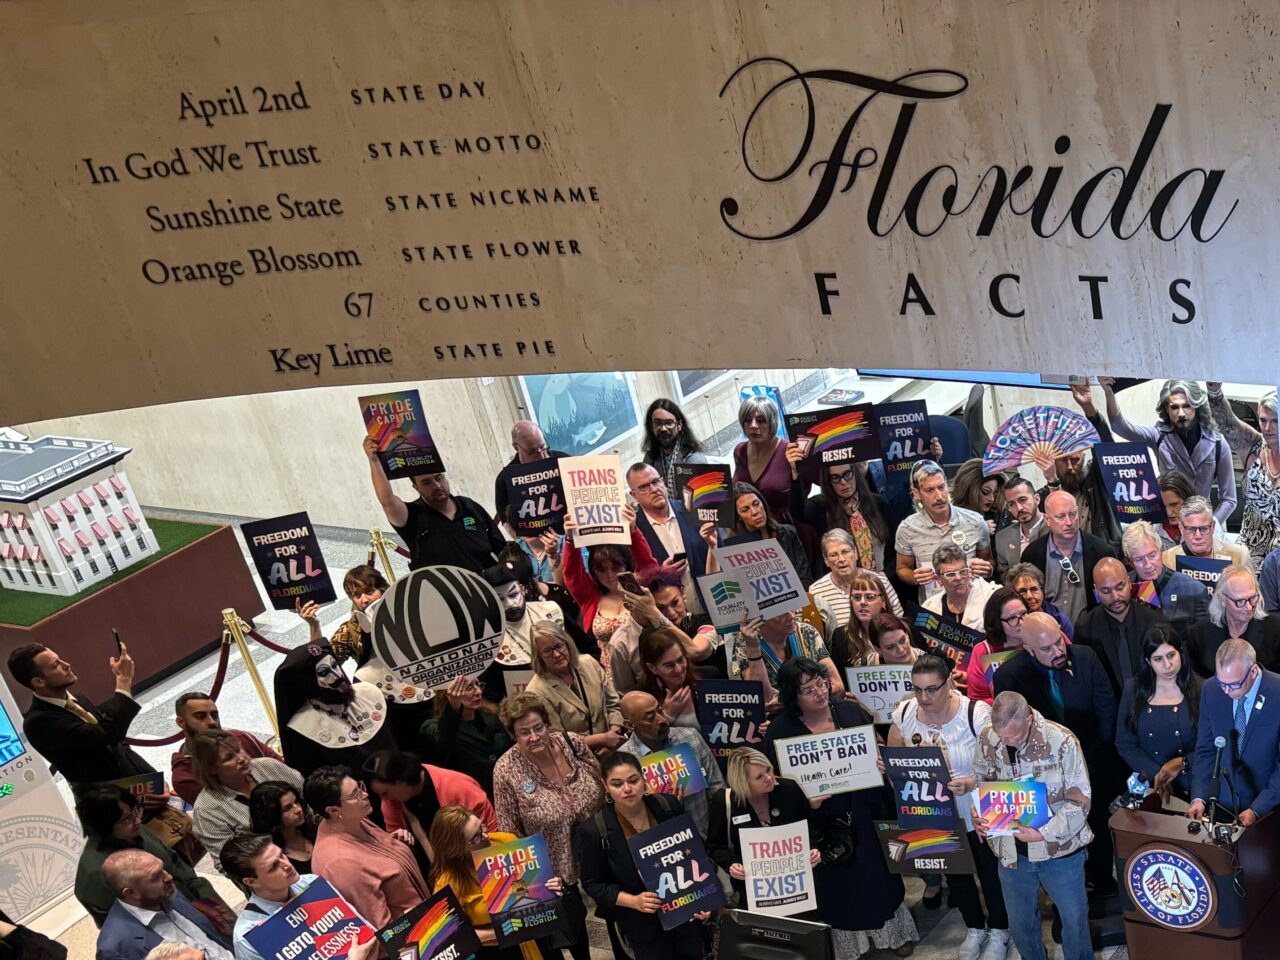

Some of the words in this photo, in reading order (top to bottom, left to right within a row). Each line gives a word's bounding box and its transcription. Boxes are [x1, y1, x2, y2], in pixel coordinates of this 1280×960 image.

[350, 83, 425, 105] STATE
[437, 81, 487, 101] DAY
[178, 88, 249, 128] April
[255, 82, 310, 116] 2nd
[367, 138, 440, 160] STATE
[455, 133, 541, 154] MOTTO
[719, 56, 1239, 243] Florida
[83, 157, 119, 185] In
[125, 148, 190, 181] God
[193, 143, 243, 174] We
[245, 140, 320, 168] Trust
[385, 189, 457, 212] STATE
[471, 185, 601, 207] NICKNAME
[145, 198, 271, 232] Sunshine
[277, 194, 344, 219] State
[401, 241, 473, 263] STATE
[486, 238, 583, 258] FLOWER
[142, 257, 245, 289] Orange
[248, 245, 362, 277] Blossom
[343, 291, 375, 319] 67
[418, 291, 541, 313] COUNTIES
[814, 272, 1196, 324] FACTS
[270, 345, 322, 377] Key
[326, 341, 393, 369] Lime
[433, 340, 504, 360] STATE
[515, 338, 556, 357] PIE
[369, 399, 413, 416] PRIDE
[377, 412, 416, 425] CAPITOL
[989, 413, 1087, 460] TOGETHER
[568, 468, 617, 487] TRANS
[571, 487, 620, 505] PEOPLE
[575, 504, 621, 526] EXIST
[253, 527, 309, 546] FREEDOM
[274, 545, 299, 557] FOR
[267, 555, 322, 585] ALL
[375, 568, 502, 669] NOW
[400, 639, 499, 677] NATIONAL
[412, 651, 493, 683] ORGANIZATION
[426, 676, 445, 688] FOR
[448, 662, 485, 679] WOMEN
[786, 740, 820, 754] FREE
[822, 733, 866, 749] STATES
[789, 749, 833, 767] DON'T
[838, 744, 868, 760] BAN
[889, 758, 941, 768] FREEDOM
[908, 770, 931, 779] FOR
[901, 780, 950, 801] ALL
[990, 790, 1037, 803] PRIDE
[901, 806, 953, 816] FLORIDIANS
[995, 803, 1038, 815] CAPITOL
[639, 828, 694, 859] FREEDOM
[749, 836, 803, 859] TRANS
[485, 845, 538, 870] PRIDE
[660, 850, 685, 867] FOR
[751, 854, 805, 876] PEOPLE
[915, 859, 948, 869] RESIST.
[1140, 853, 1193, 874] SENATE
[493, 859, 542, 881] CAPITOL
[656, 859, 710, 899] ALL
[753, 871, 806, 899] EXIST
[662, 884, 718, 913] FLORIDIANS
[1132, 873, 1156, 912] STATE
[1157, 911, 1173, 922] OF
[1177, 885, 1208, 924] FLORIDA
[285, 908, 308, 929] END
[309, 906, 345, 937] YOUTH
[523, 908, 556, 923] EQUALITY
[524, 915, 558, 928] FLORIDA
